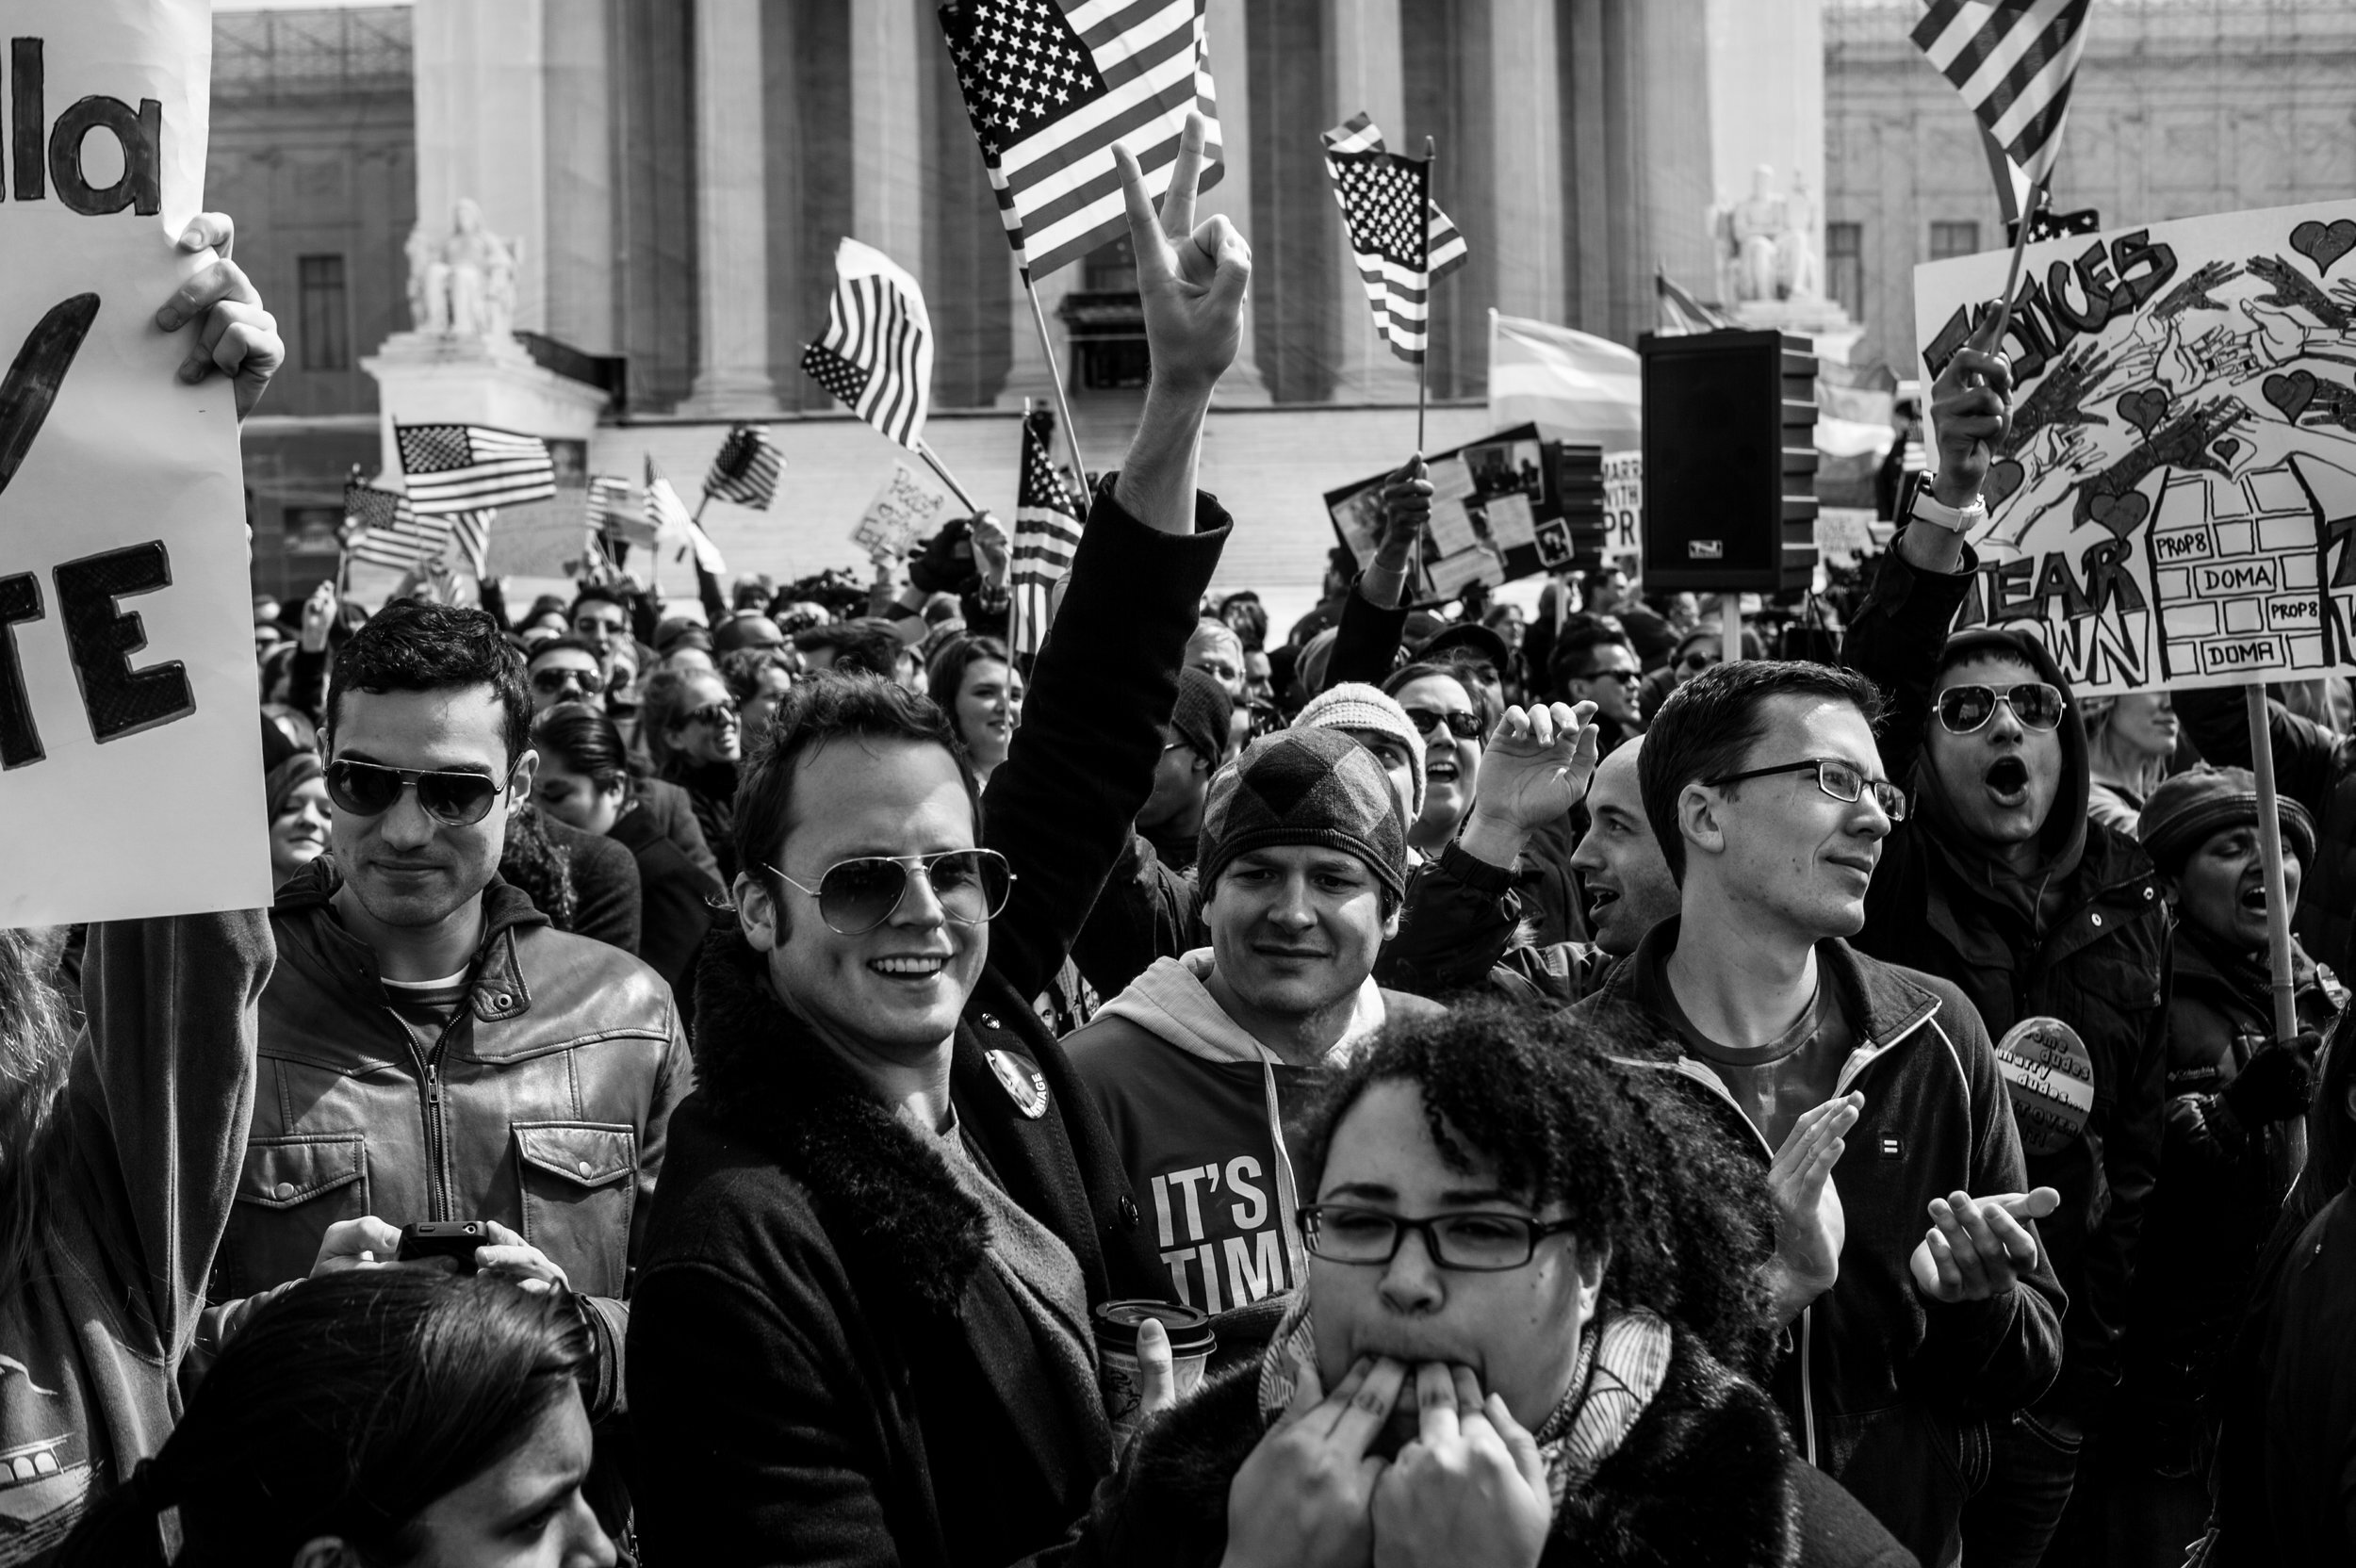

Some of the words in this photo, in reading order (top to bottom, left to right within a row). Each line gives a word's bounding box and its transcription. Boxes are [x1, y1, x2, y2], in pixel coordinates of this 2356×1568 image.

[0, 37, 162, 217] la
[1602, 510, 1636, 547] PR
[2204, 565, 2272, 591] DOMA
[2001, 609, 2150, 689] WN
[2208, 641, 2275, 665] DOMA
[2023, 1031, 2069, 1054] ome
[1997, 1048, 2052, 1081] marry
[2039, 1048, 2090, 1082] dudes
[2032, 1105, 2079, 1137] OVER
[1151, 1155, 1268, 1248] IT'S
[1159, 1229, 1284, 1315] TIM
